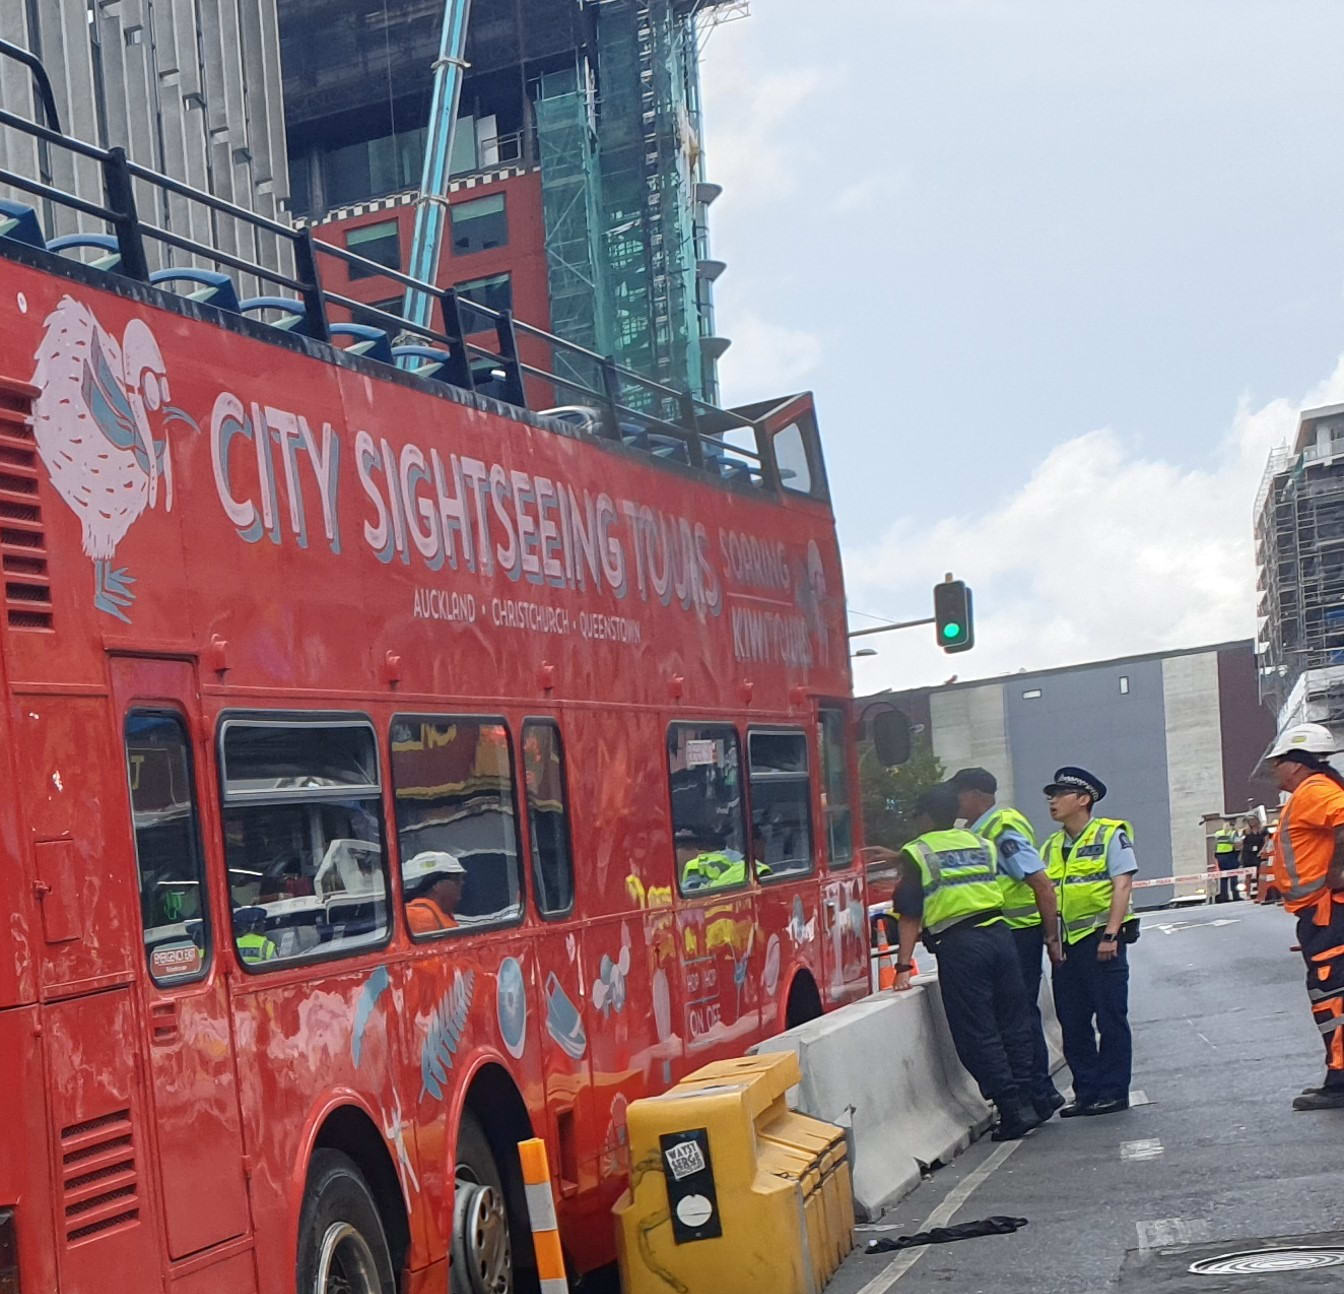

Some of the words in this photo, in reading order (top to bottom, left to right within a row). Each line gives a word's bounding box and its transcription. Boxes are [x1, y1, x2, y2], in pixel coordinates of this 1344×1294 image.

[210, 390, 340, 554] CITY
[354, 428, 627, 598] SIGHTSEEING
[623, 499, 724, 616] TOURS
[413, 588, 476, 624] AUCKLAND
[491, 598, 570, 634] CHRISTCHURCH
[579, 611, 642, 645] QUEENSTOWN
[689, 1008, 704, 1037] ON
